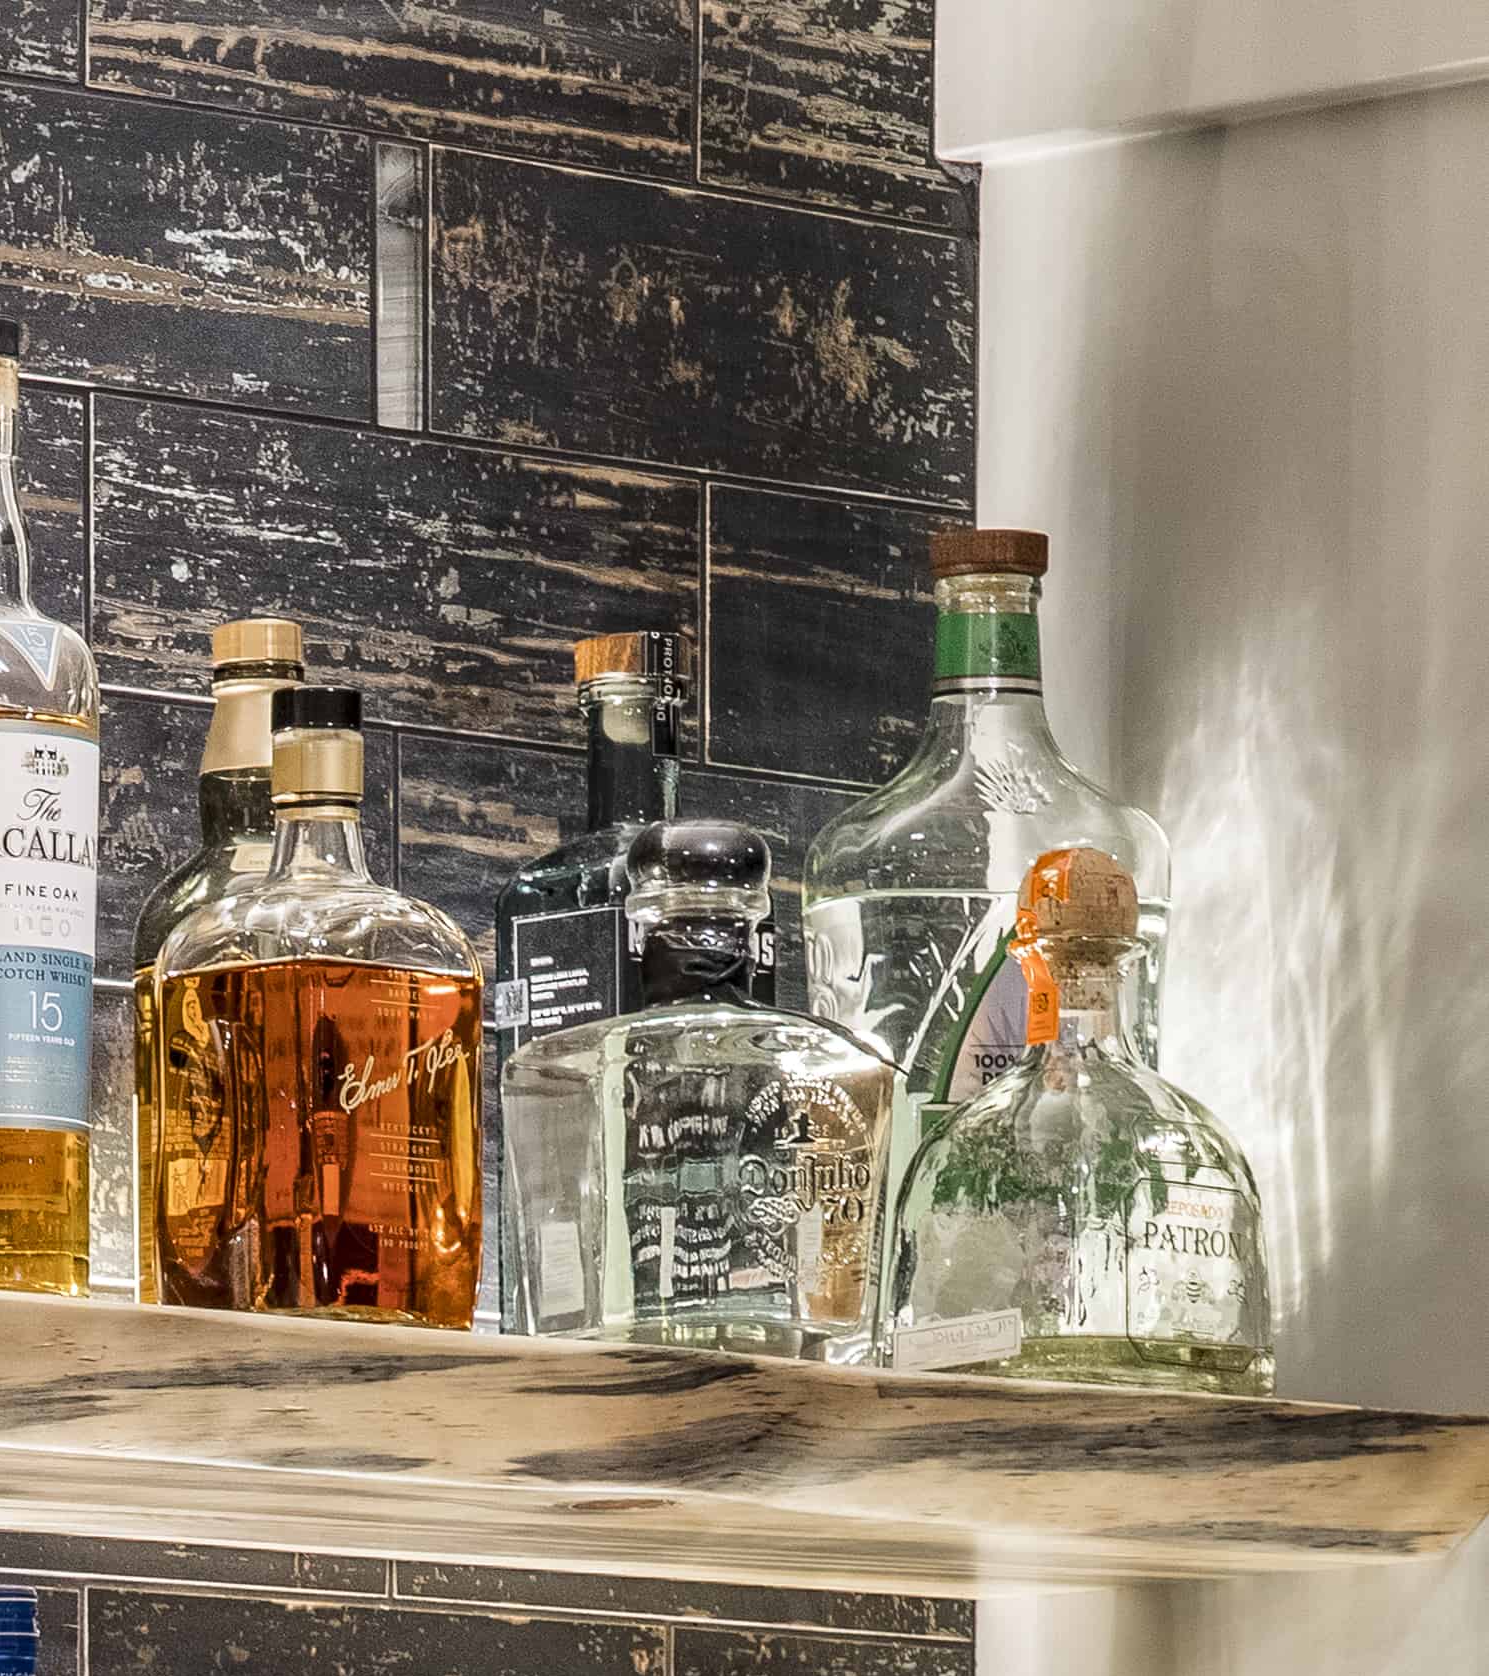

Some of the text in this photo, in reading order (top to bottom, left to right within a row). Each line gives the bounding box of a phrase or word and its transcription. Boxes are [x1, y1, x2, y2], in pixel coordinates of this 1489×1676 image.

[16, 788, 61, 821] The
[5, 884, 78, 901] FINE OAK
[41, 954, 79, 969] SINGLE
[50, 971, 85, 987] WHISKY
[30, 990, 63, 1031] 15
